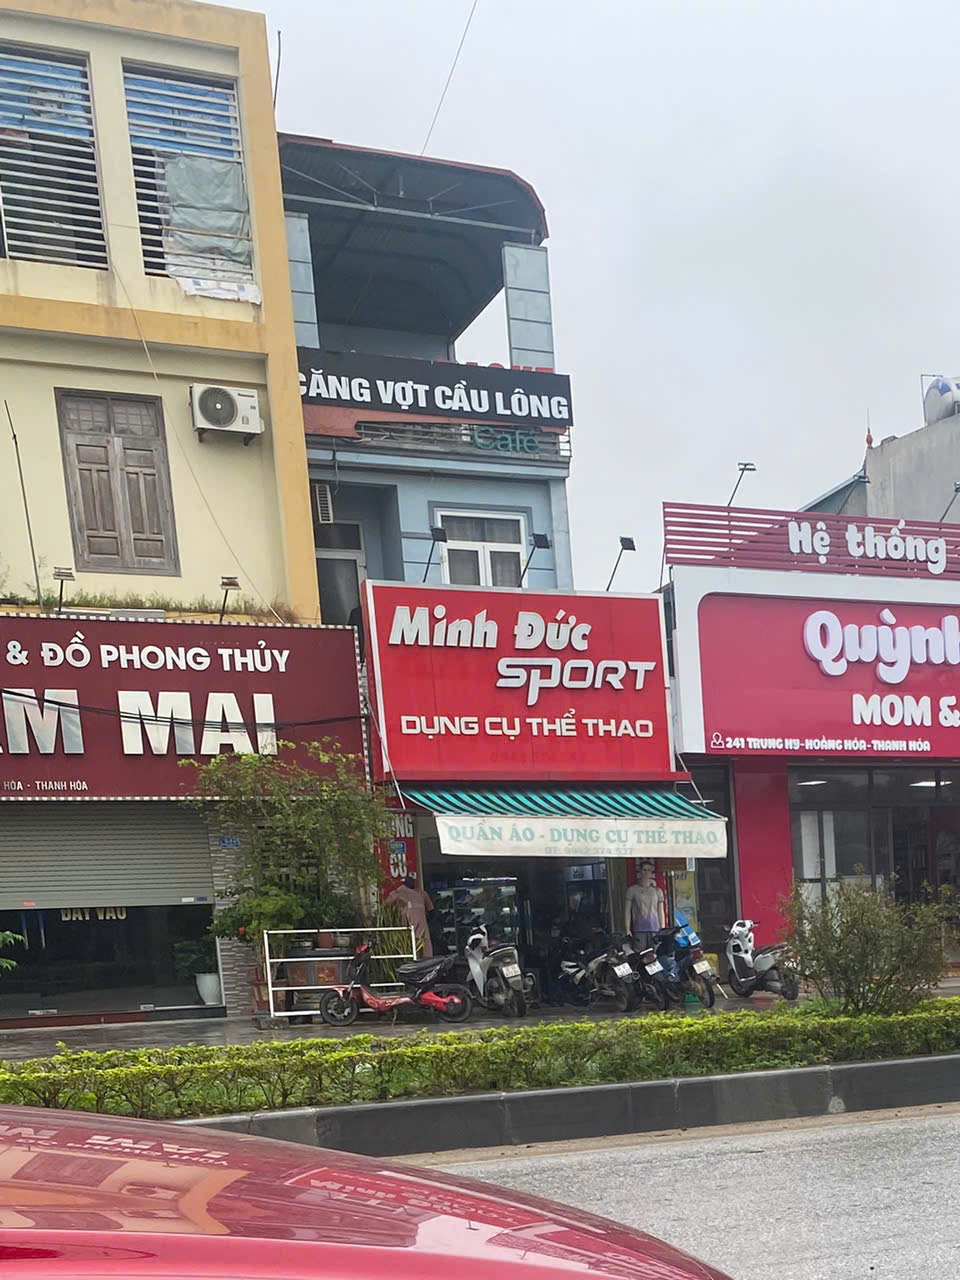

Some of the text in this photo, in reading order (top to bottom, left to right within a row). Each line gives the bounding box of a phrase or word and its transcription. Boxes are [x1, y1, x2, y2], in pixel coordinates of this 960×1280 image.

[376, 380, 430, 410] VỢT
[434, 379, 490, 413] CẦU
[495, 388, 570, 420] LÔNG
[788, 521, 831, 565] Hệ
[845, 519, 947, 575] thống
[388, 604, 593, 651] Minh Đức
[6, 631, 290, 672] & ĐỒ PHONG THỦY
[496, 657, 657, 706] SPORT
[0, 687, 279, 756] M MAI
[400, 709, 654, 740] DỤNG CỤ THỂ THAO
[852, 693, 932, 727] MOM
[725, 737, 745, 749] 241
[747, 737, 783, 750] TRUNG
[908, 737, 931, 752] HÓA
[35, 781, 68, 791] THANH
[70, 780, 89, 791] HÓA
[448, 819, 503, 841] QUẦN
[510, 824, 535, 841] ÁO
[550, 827, 600, 846] DỤNG
[605, 829, 629, 847] CỤ
[671, 829, 718, 845] THAO
